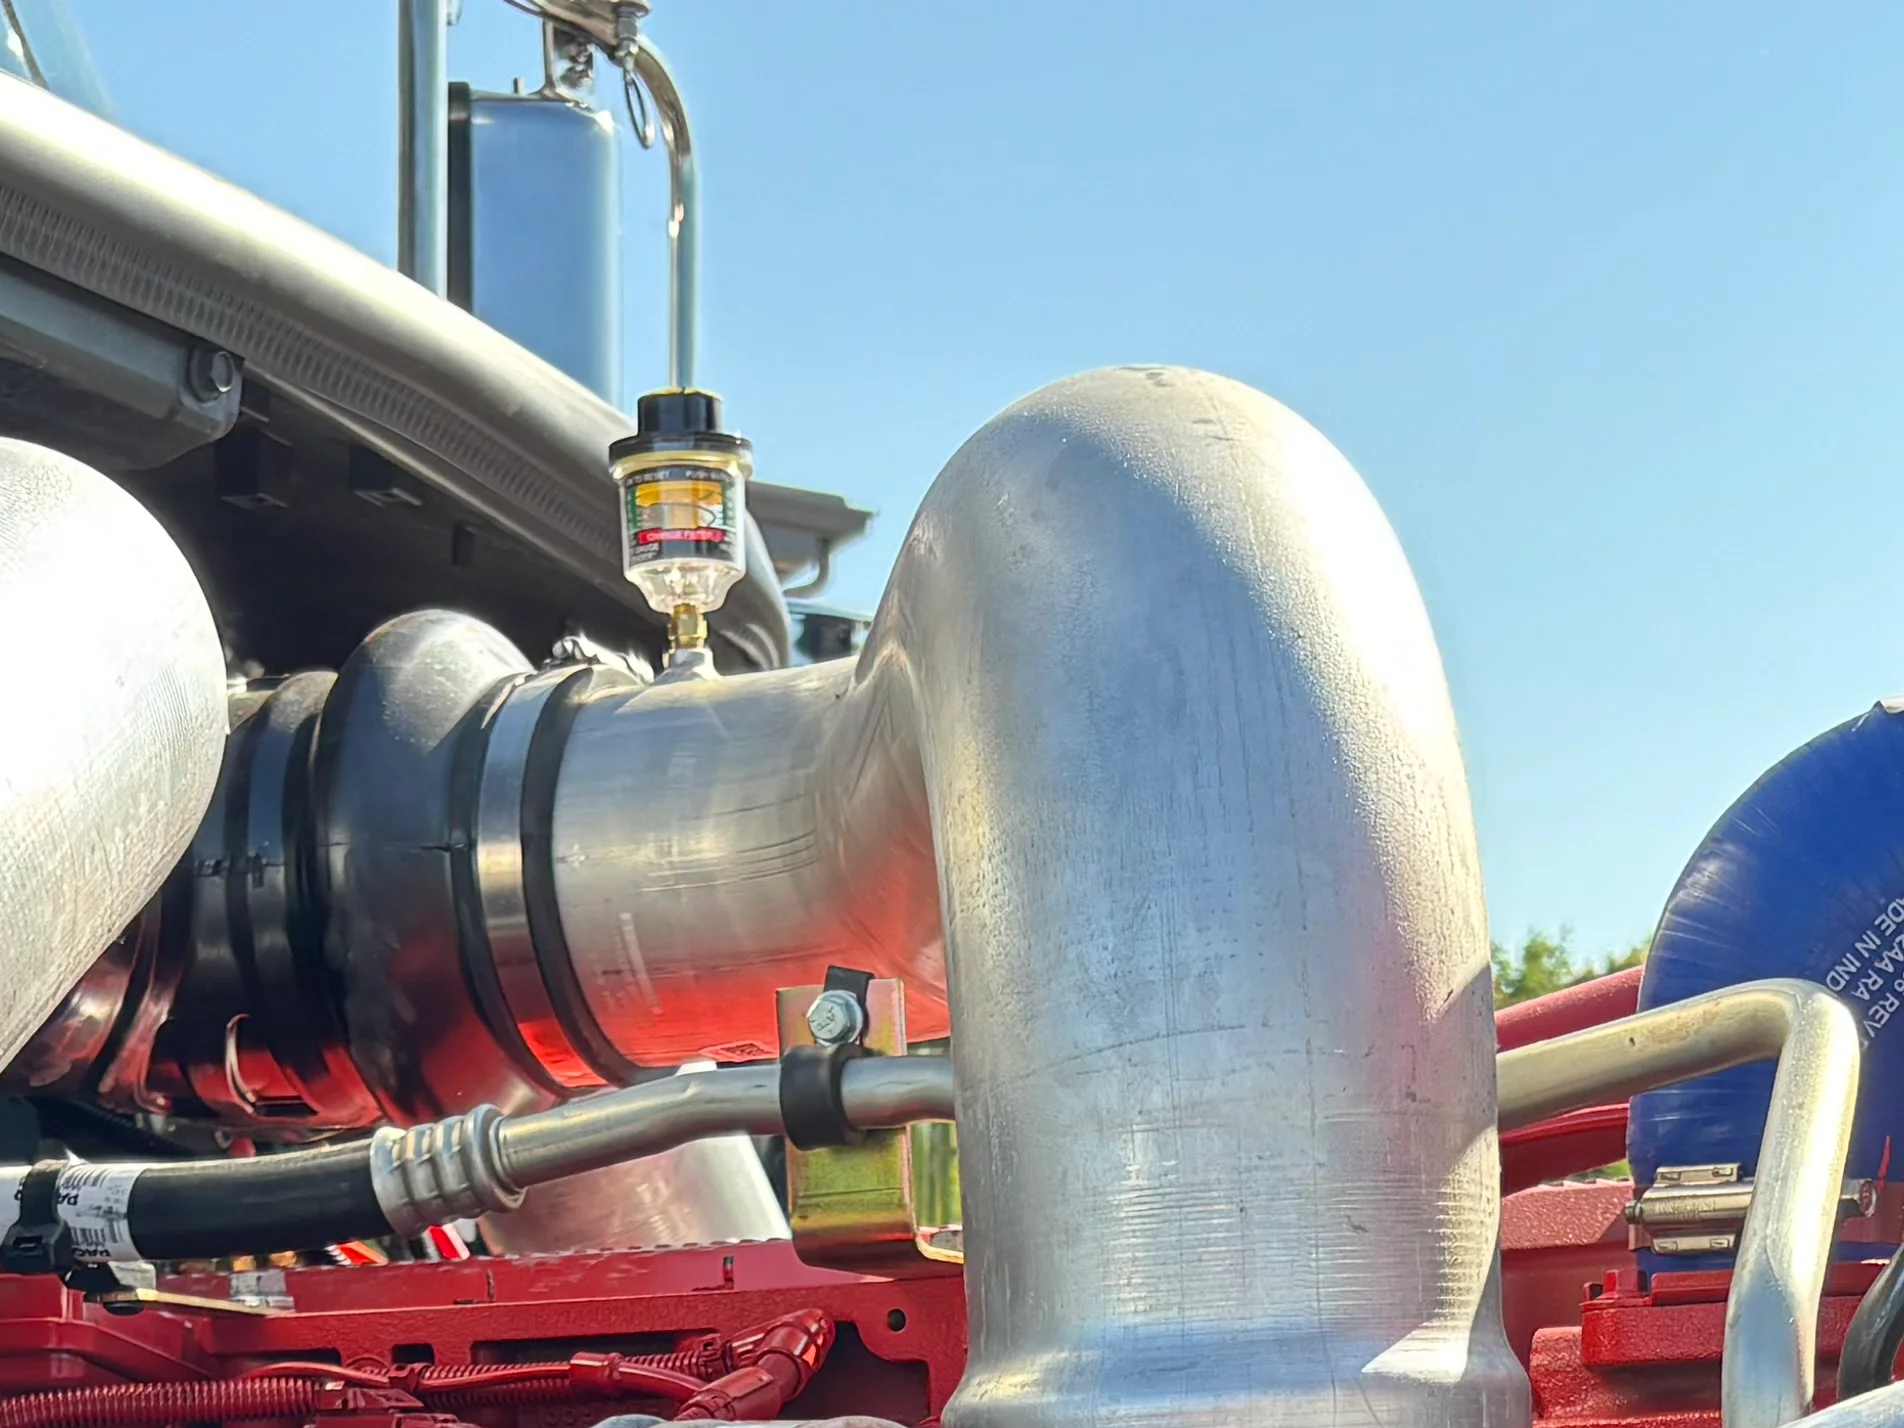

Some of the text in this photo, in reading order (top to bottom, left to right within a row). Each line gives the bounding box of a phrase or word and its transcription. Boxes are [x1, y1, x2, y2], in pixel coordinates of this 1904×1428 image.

[1854, 930, 1882, 959] IN
[1825, 952, 1861, 993] IND
[1862, 992, 1900, 1039] REV
